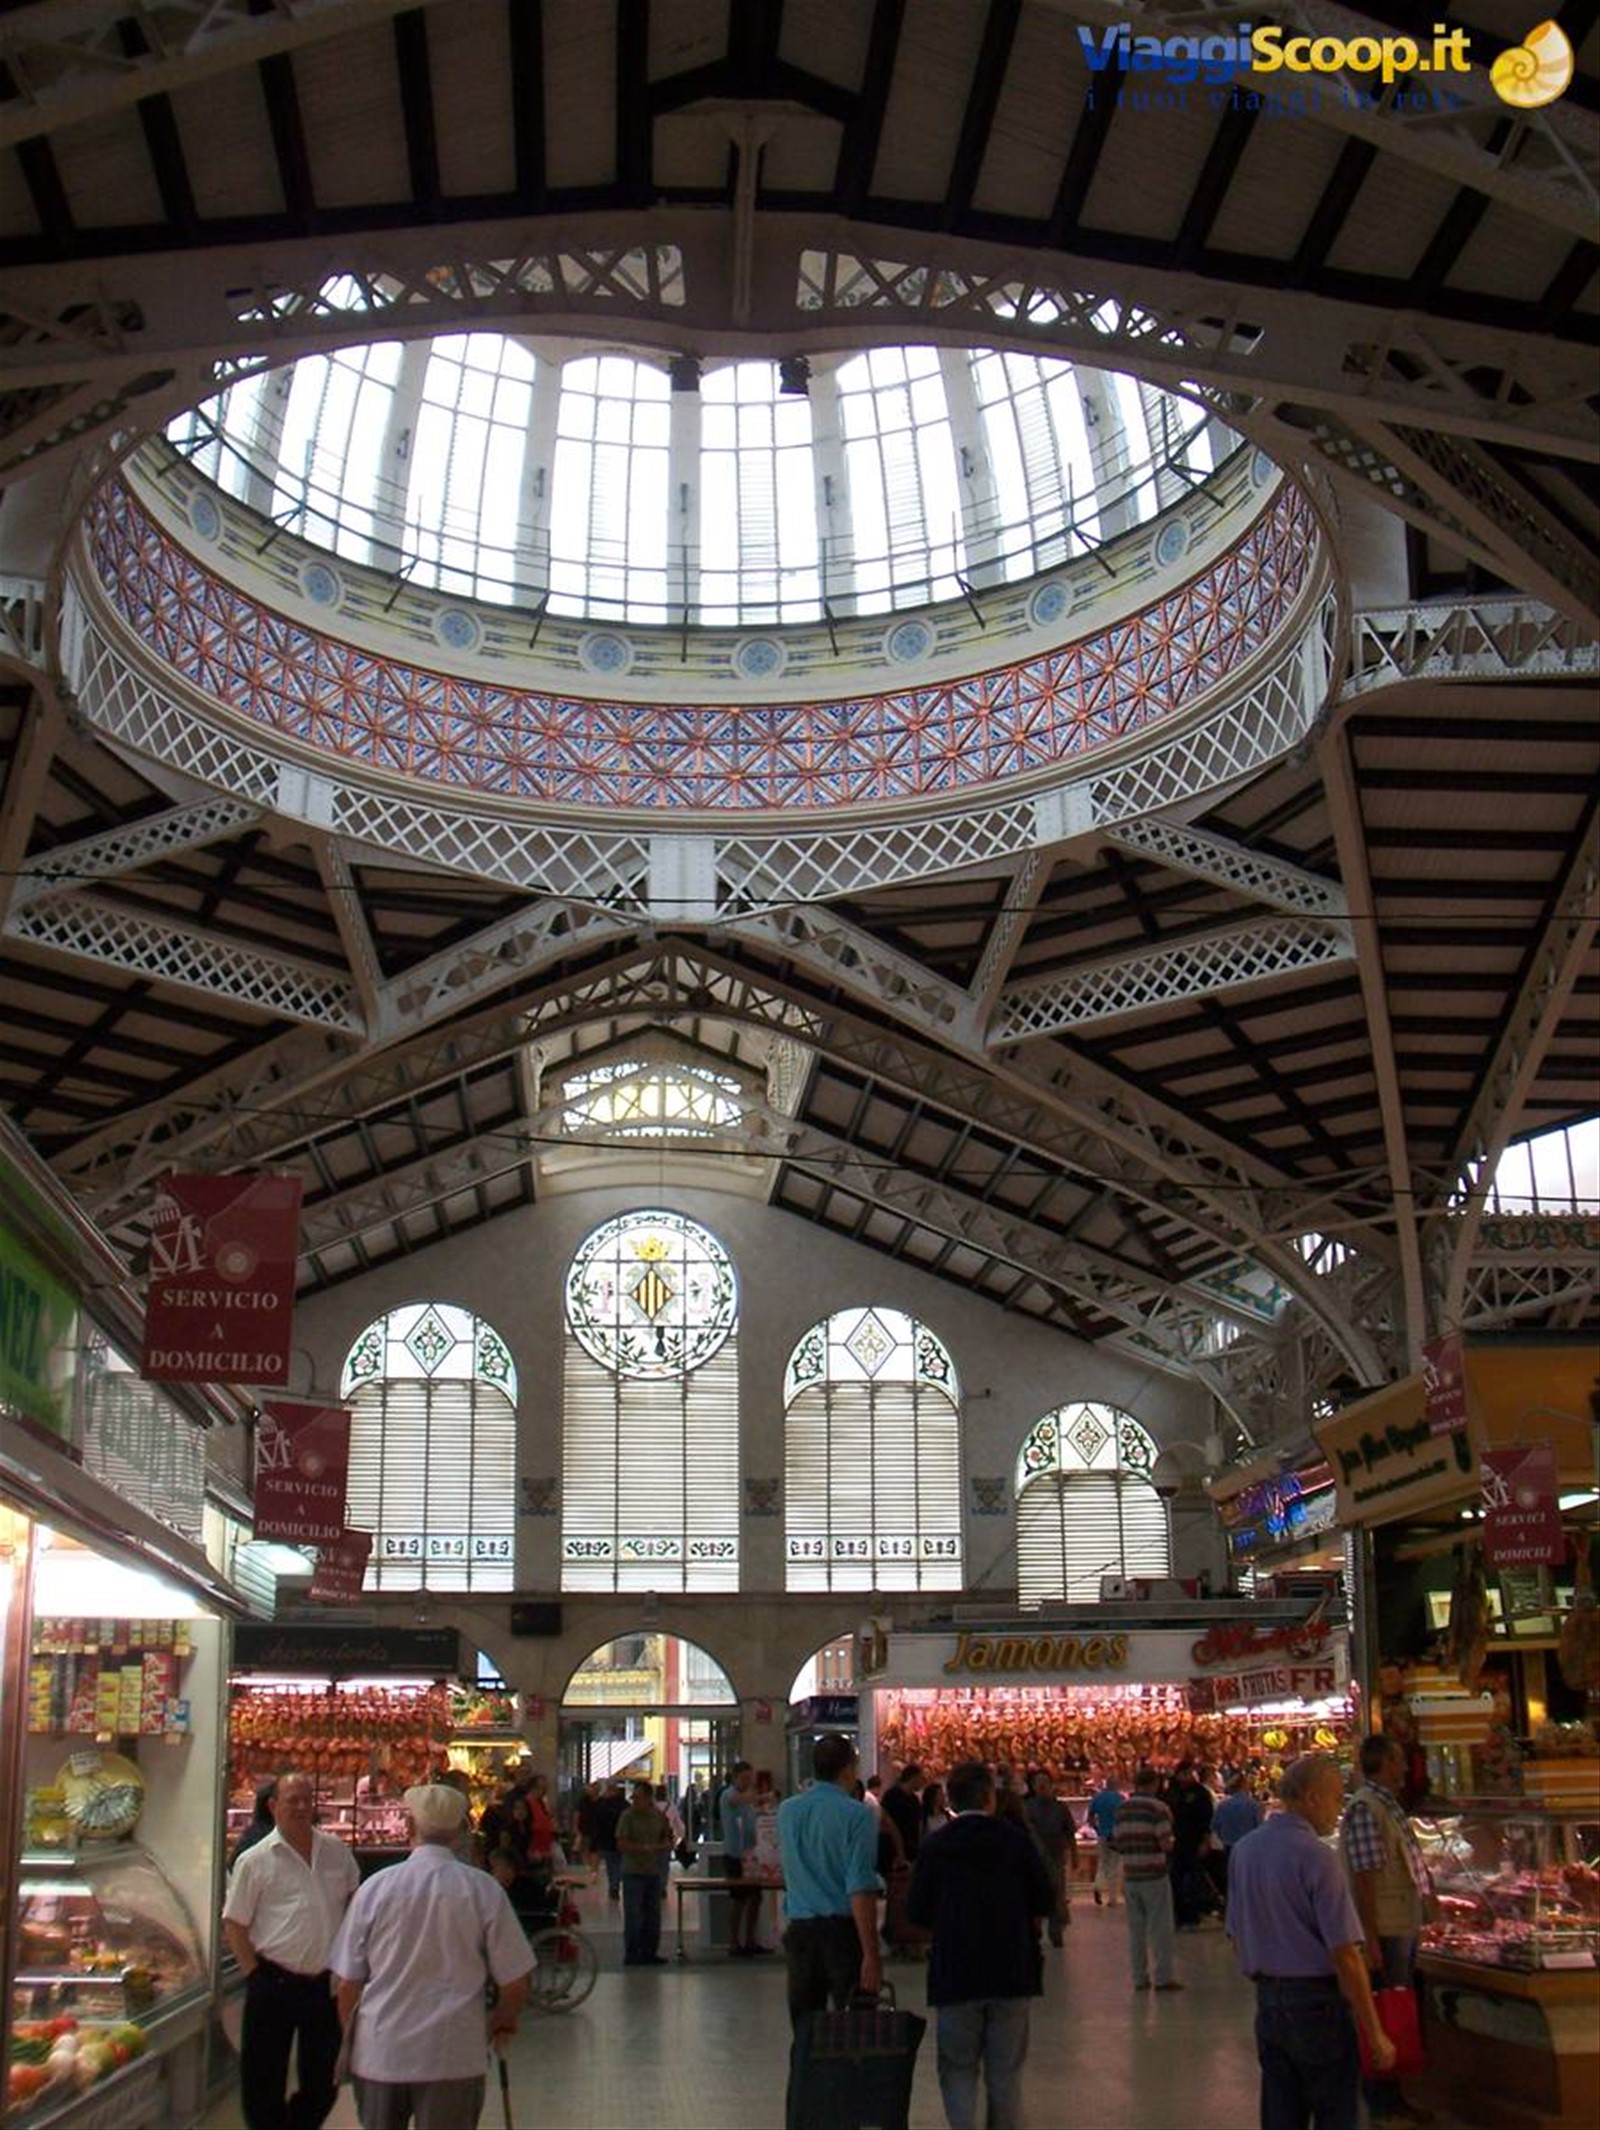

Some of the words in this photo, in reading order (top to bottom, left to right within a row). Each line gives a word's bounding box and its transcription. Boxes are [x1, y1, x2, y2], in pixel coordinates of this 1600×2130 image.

[161, 1288, 279, 1310] SERVICIO
[209, 1322, 226, 1343] A
[148, 1350, 283, 1373] DOMICILIO
[264, 1479, 339, 1498] SERVICIO
[296, 1503, 307, 1517] A
[257, 1520, 341, 1538] DOMICILIO
[944, 1630, 1130, 1673] Jamones
